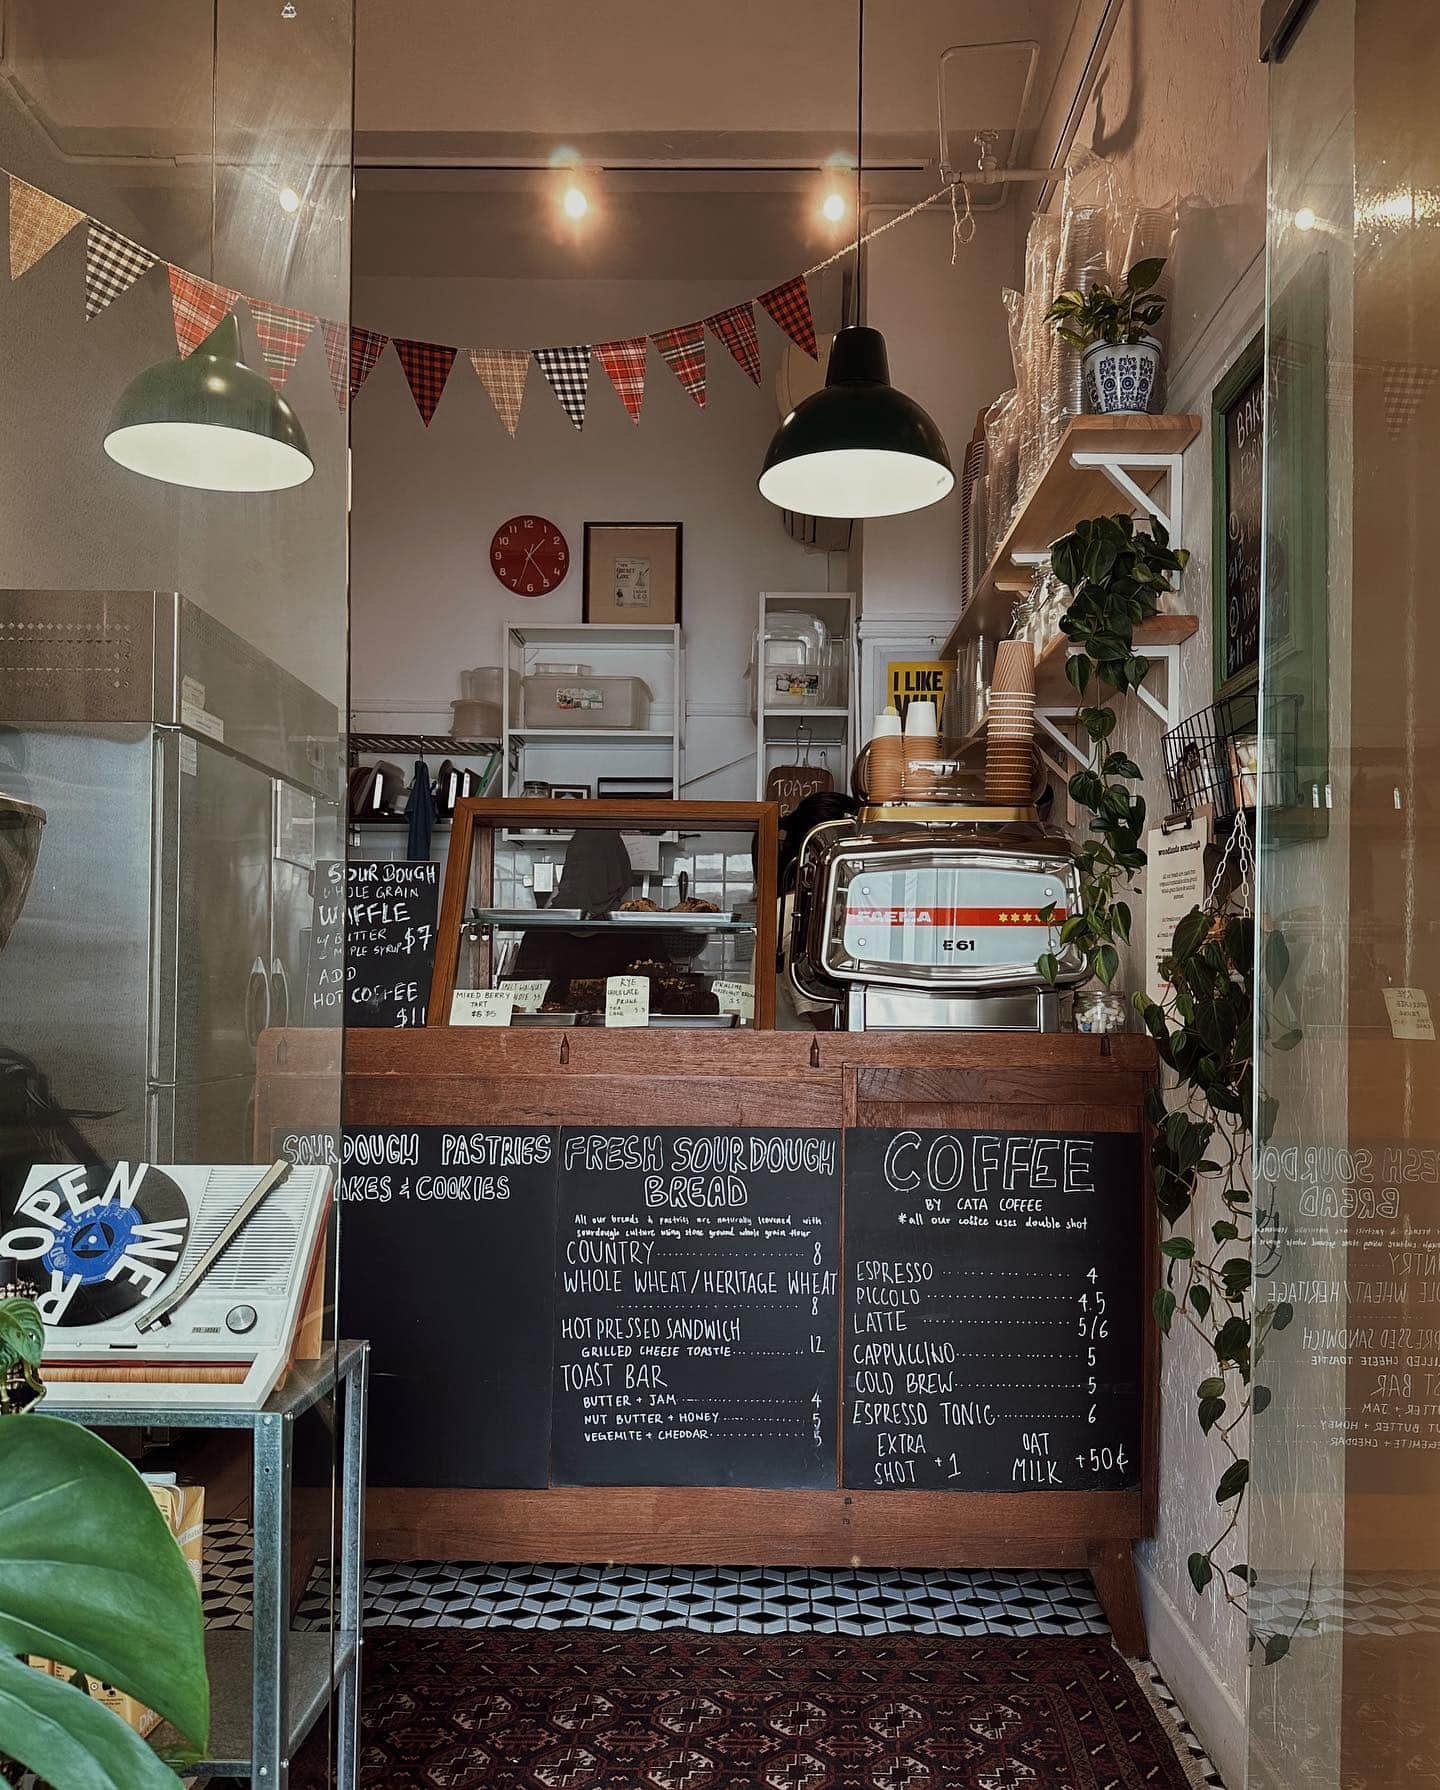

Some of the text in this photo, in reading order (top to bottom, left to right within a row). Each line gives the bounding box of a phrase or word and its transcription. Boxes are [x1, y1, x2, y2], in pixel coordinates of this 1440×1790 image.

[509, 525, 518, 534] 11
[524, 520, 534, 529] 12
[543, 525, 547, 533] 1
[499, 537, 509, 545] 10
[553, 537, 560, 545] 2
[495, 552, 502, 560] 9
[558, 552, 565, 561] 3
[500, 567, 506, 576] 8
[554, 567, 560, 576] 4
[511, 579, 518, 587] 7
[527, 583, 534, 592] 6
[543, 579, 550, 588] 5
[893, 671, 943, 692] I LIKE
[773, 779, 823, 797] TOAST
[376, 886, 419, 899] GRAIN
[857, 911, 932, 922] FAEMA
[402, 924, 433, 954] $7
[333, 945, 368, 957] MPLE
[374, 942, 402, 957] SYRUP
[319, 967, 356, 985] ADD
[620, 978, 637, 987] RYE
[313, 990, 343, 1010] HOT
[394, 1007, 426, 1028] $11
[283, 1133, 551, 1167] SOURDOUGH PASTRIES
[564, 1135, 836, 1175] FRESH SOURDOUGH
[884, 1131, 1095, 1192] COFFEE
[333, 1175, 391, 1202] AKES
[416, 1175, 511, 1201] COOKIES
[645, 1175, 748, 1207] BREAD
[0, 1161, 149, 1260] OPEN
[925, 1198, 1042, 1212] BY CATA COFFEE
[574, 1214, 587, 1225] All
[592, 1216, 606, 1224] our
[611, 1214, 639, 1225] breads
[697, 1216, 711, 1225] are
[717, 1215, 752, 1226] naturally
[803, 1215, 822, 1225] with
[931, 1216, 951, 1225] our
[958, 1214, 989, 1226] coffee
[995, 1217, 1017, 1228] uses
[1025, 1215, 1061, 1229] double
[1065, 1218, 1088, 1230] shot
[577, 1227, 812, 1240] sourdough culture using stone ground whole grain flour
[567, 1239, 822, 1265] COUNTRY 8
[563, 1269, 622, 1294] WHOLE
[856, 1260, 1098, 1284] ESPRESSO 4
[788, 1270, 838, 1295] WHEAT
[811, 1296, 818, 1316] 8
[856, 1287, 1106, 1315] PICCOLO 4.5
[561, 1317, 741, 1342] HOT PRESSED SANDWICH
[854, 1310, 1108, 1340] LATTE 5/6
[581, 1335, 825, 1358] GRILLED CHEESE TOASTIE 12
[853, 1341, 1096, 1367] CAPPUCCINO 5
[560, 1362, 668, 1391] TOAST BAR
[855, 1371, 1096, 1395] COLD BREW 5
[583, 1391, 822, 1412] BUTTER + JAM 4
[584, 1411, 822, 1431] NUT BUTTER + HONEY 5
[853, 1400, 1096, 1426] ESPRESSO TONIC 6
[584, 1430, 643, 1442] VEGEMITE
[658, 1429, 710, 1441] CHEDDAR
[813, 1431, 822, 1448] 5
[877, 1432, 926, 1457] EXTRA
[1023, 1432, 1049, 1455] OAT
[874, 1460, 917, 1485] SHOT
[1012, 1458, 1062, 1484] MILK
